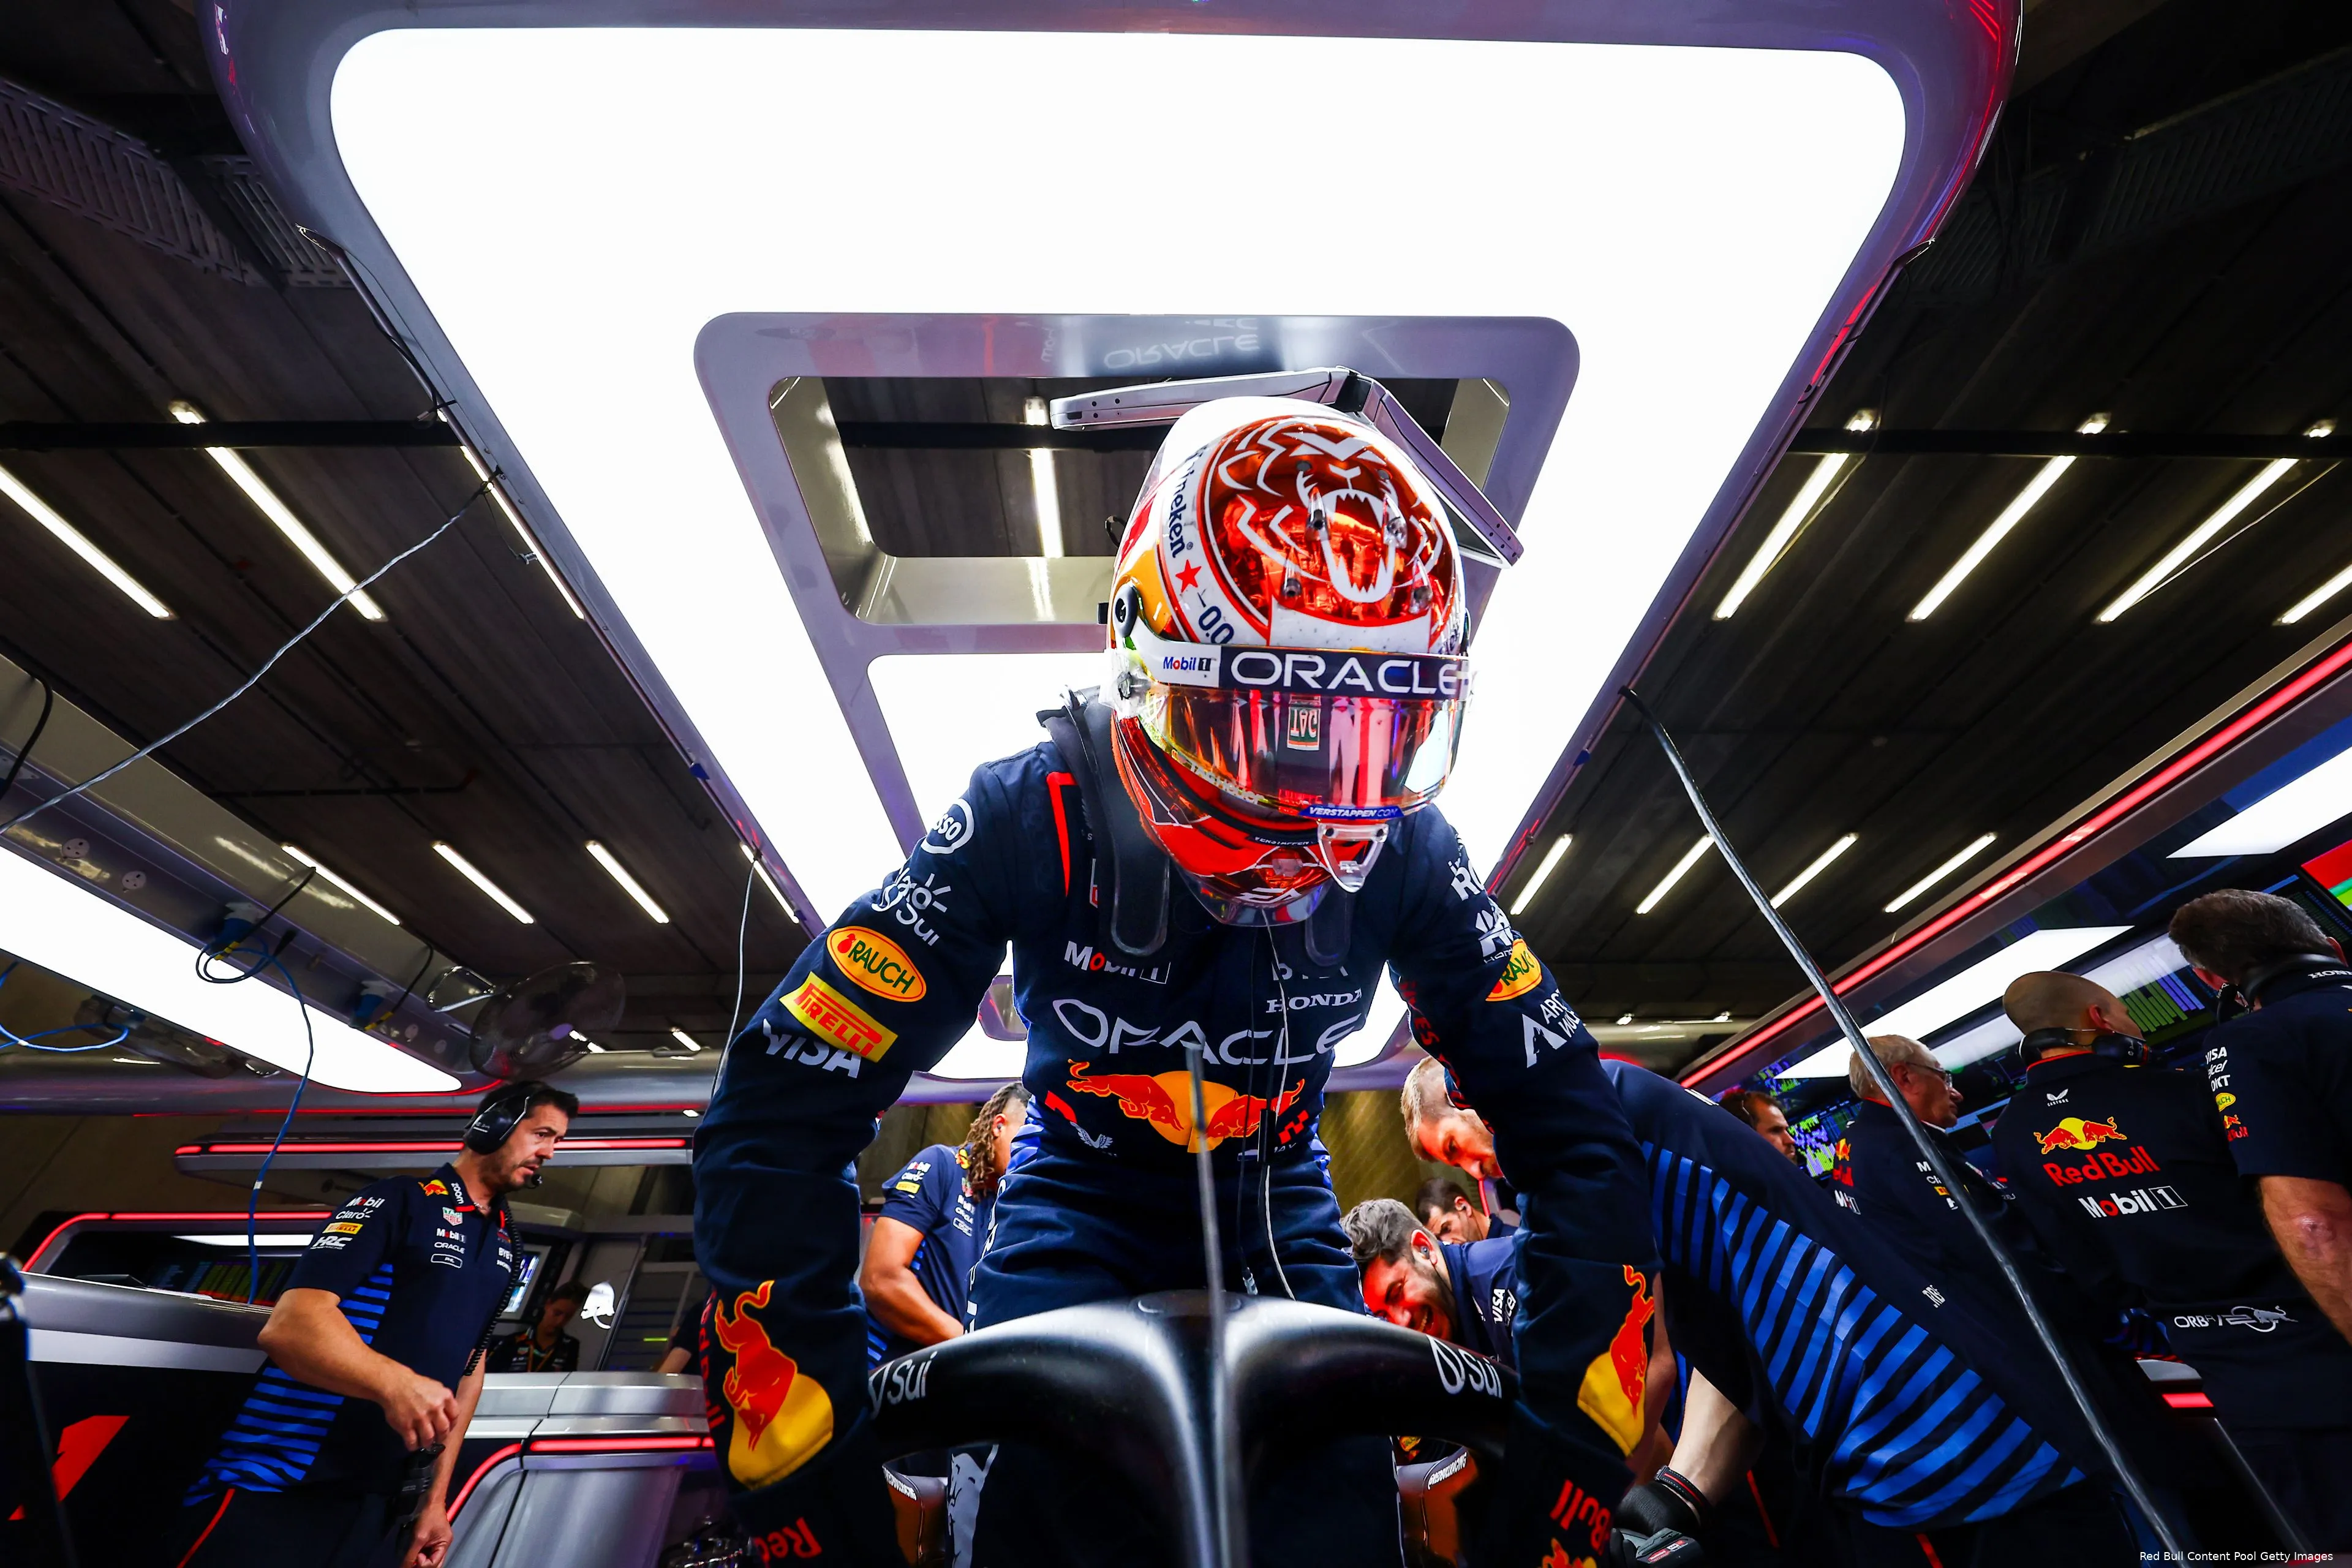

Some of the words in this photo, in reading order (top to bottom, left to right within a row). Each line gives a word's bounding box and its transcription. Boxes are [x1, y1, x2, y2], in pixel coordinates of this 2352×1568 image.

[1164, 657, 1196, 671] Mobil
[1199, 658, 1210, 671] 1
[1231, 651, 1458, 695] ORACLE
[848, 940, 915, 994] RAUCH
[1265, 987, 1362, 1013] HONDA
[793, 982, 883, 1057] PIRELLI
[1053, 999, 1362, 1065] ORACLE
[763, 1018, 862, 1078] VISA
[2206, 1047, 2227, 1065] VISA
[2043, 1153, 2107, 1187] Red
[2097, 1145, 2161, 1181] Bull
[345, 1196, 385, 1208] Mobil
[451, 1182, 464, 1204] zoom
[2078, 1189, 2157, 1219] Mobil
[335, 1210, 366, 1219] Claro
[434, 1242, 466, 1254] ORACLE
[437, 1228, 459, 1240] Mobil
[1492, 1289, 1506, 1324] VISA
[887, 1351, 938, 1404] Sui
[1458, 1348, 1502, 1399] Sui
[1550, 1479, 1611, 1556] Bull
